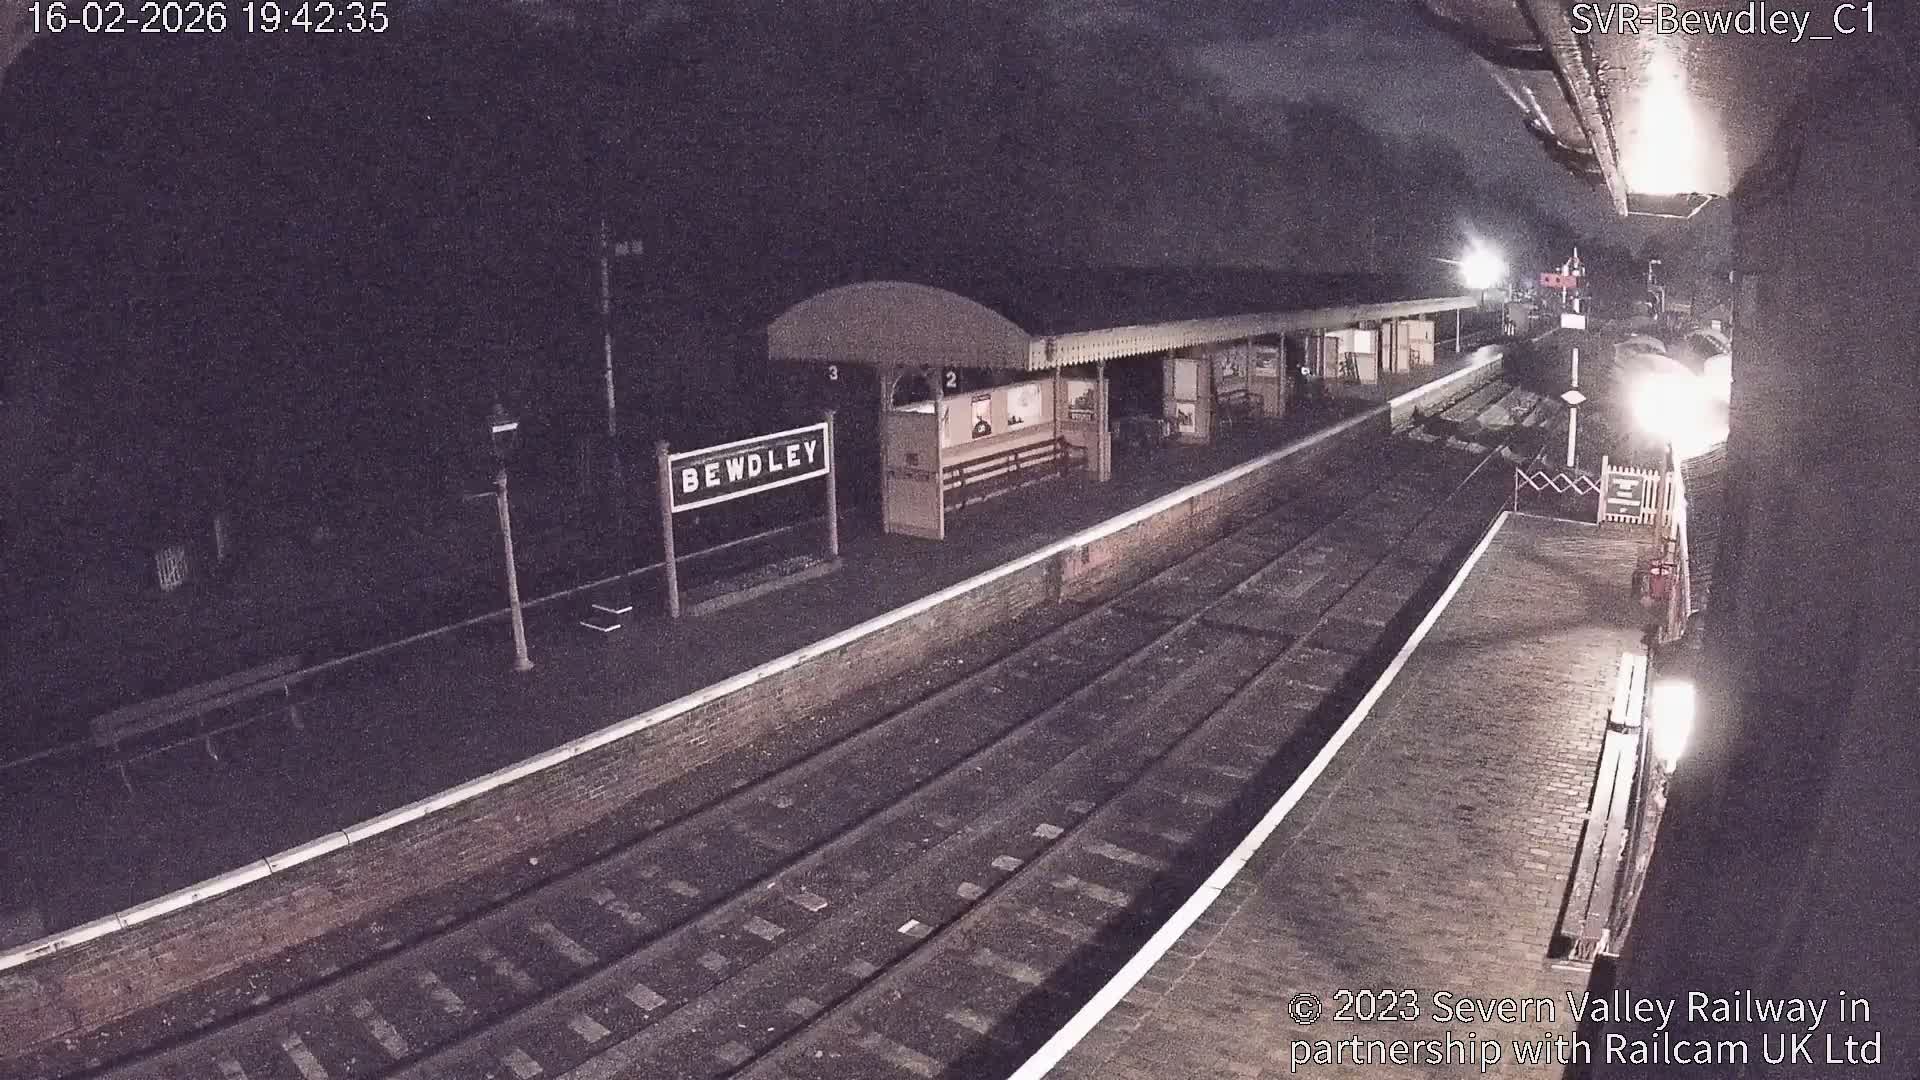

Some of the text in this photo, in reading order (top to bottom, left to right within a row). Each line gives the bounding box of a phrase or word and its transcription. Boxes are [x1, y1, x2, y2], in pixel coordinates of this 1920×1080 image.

[828, 365, 839, 380] 3
[946, 371, 957, 388] 2
[682, 440, 817, 493] BEWDLEY
